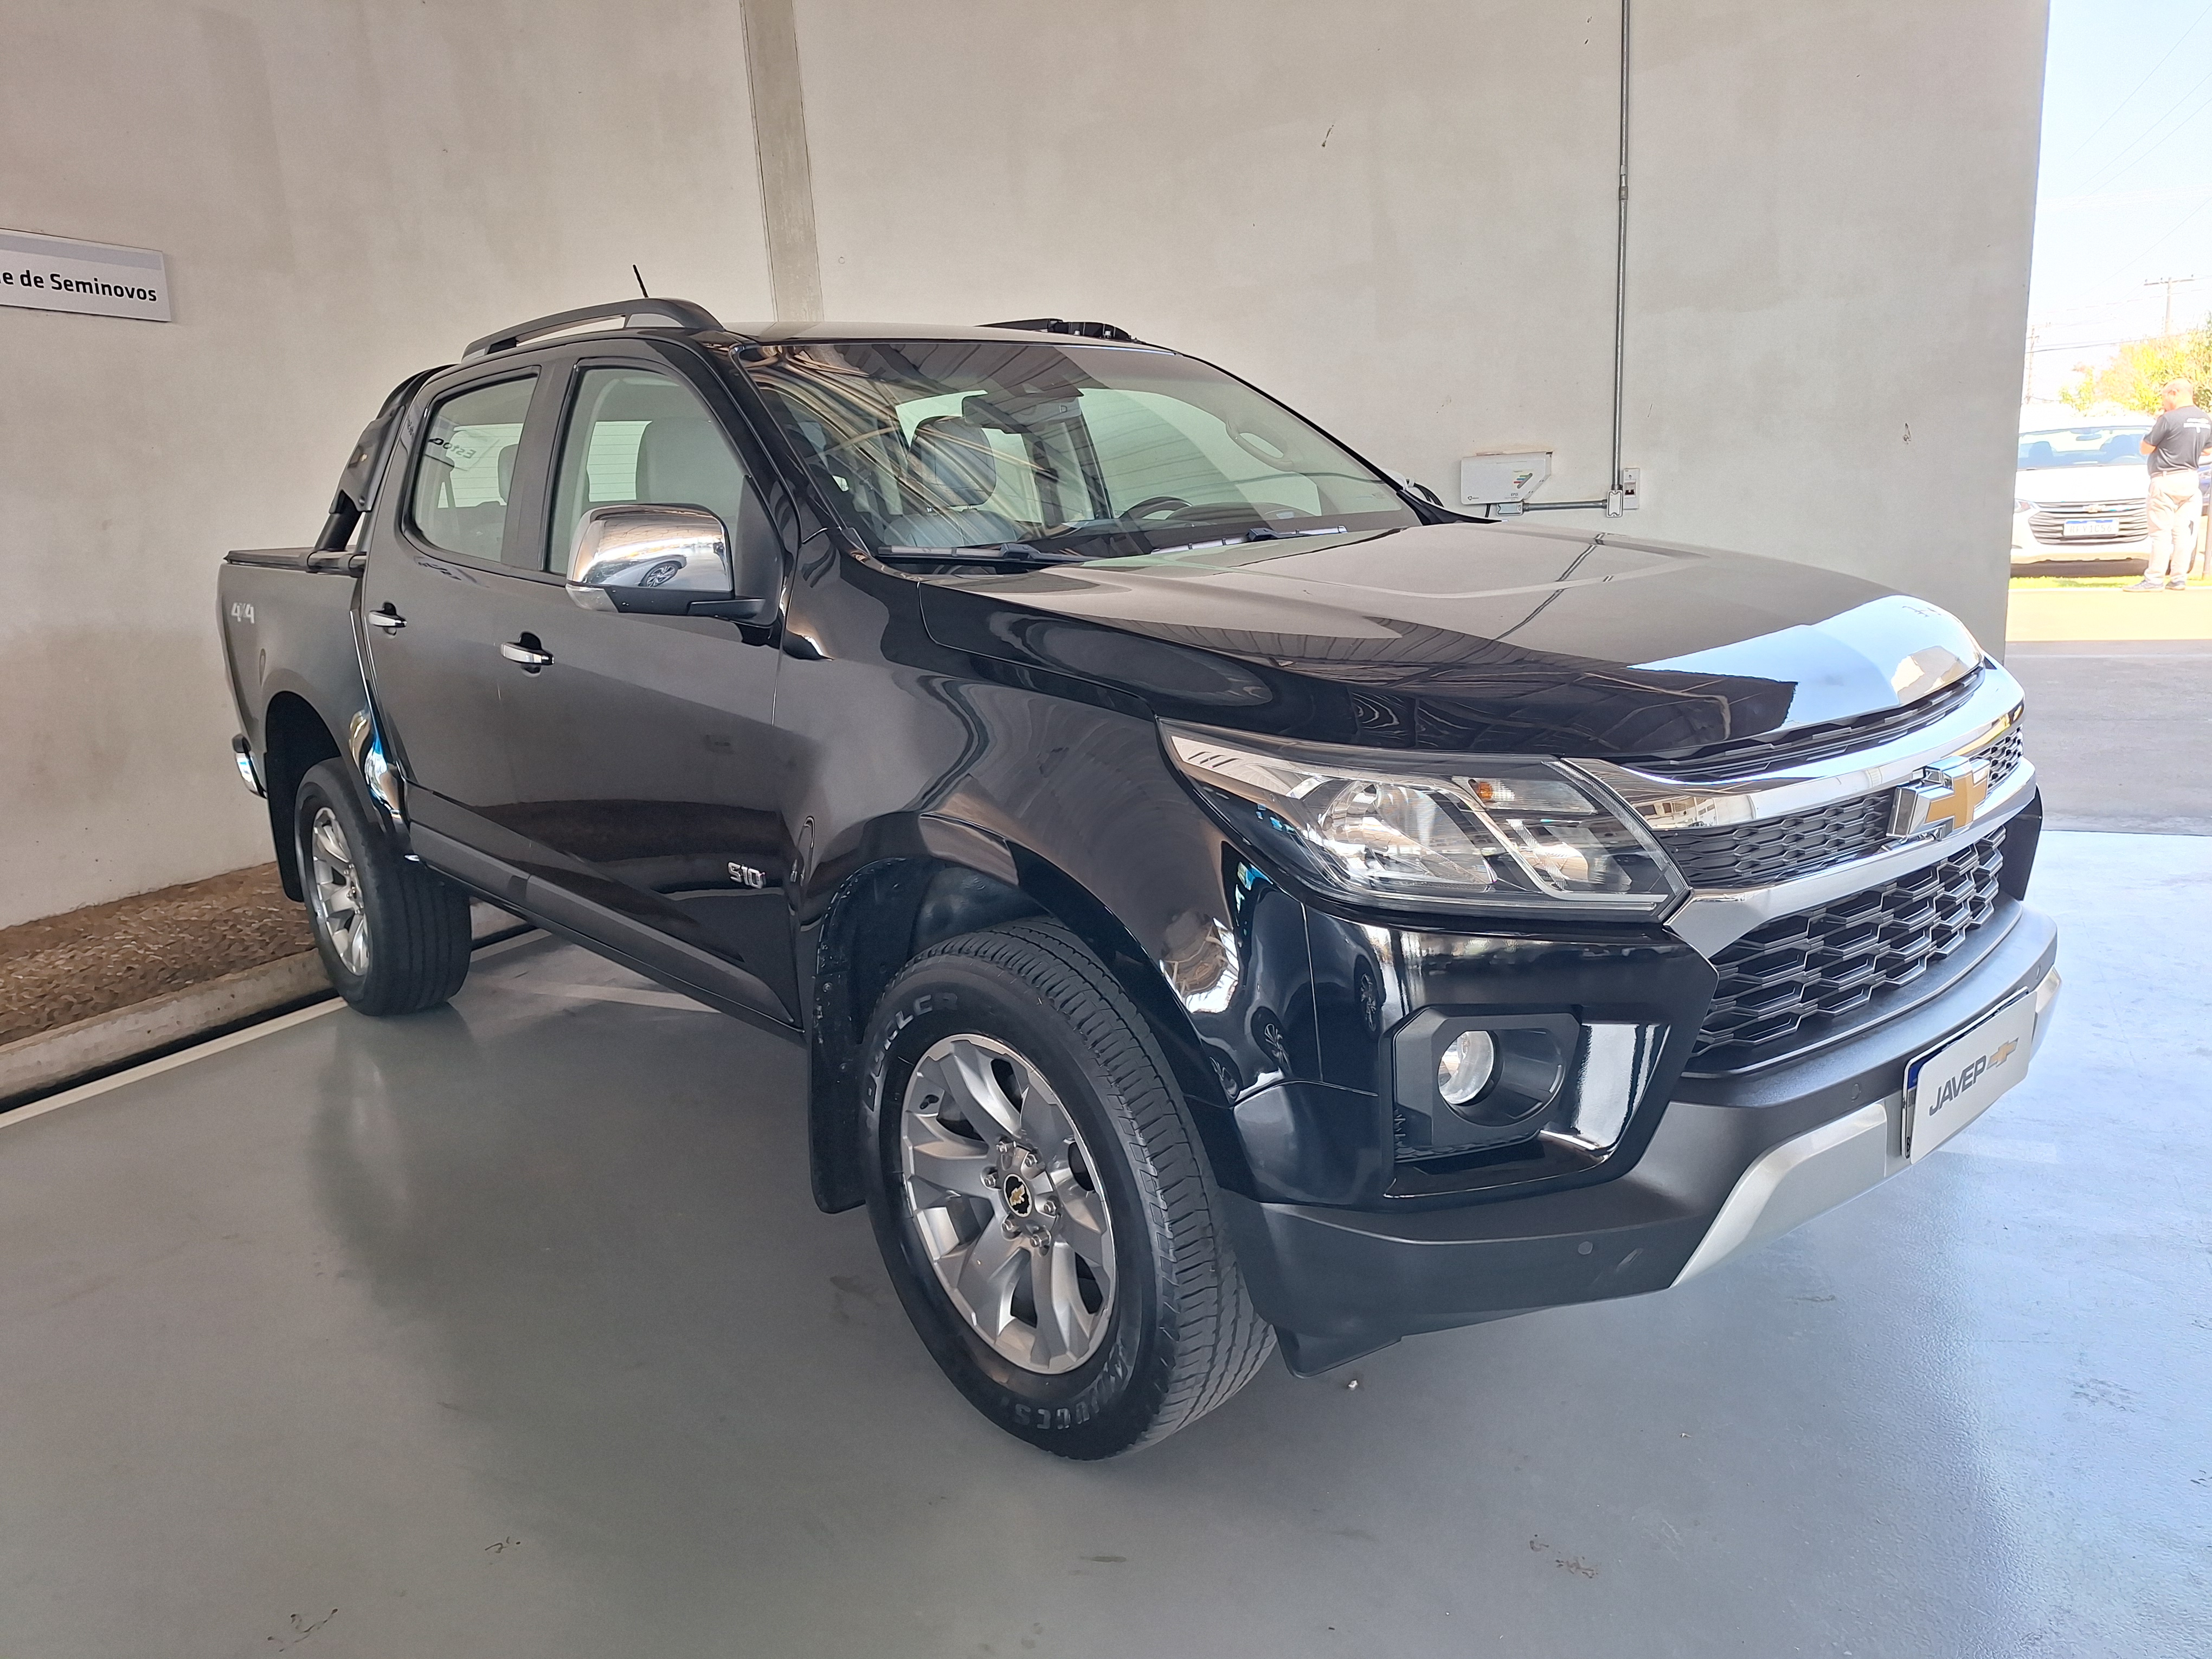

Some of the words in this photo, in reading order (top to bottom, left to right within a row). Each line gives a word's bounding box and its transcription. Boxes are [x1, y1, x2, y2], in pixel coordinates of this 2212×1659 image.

[0, 271, 14, 285] e
[20, 270, 44, 288] de
[50, 274, 157, 301] Seminovos
[728, 862, 763, 889] S10
[1929, 1054, 1987, 1116] JAVEP
